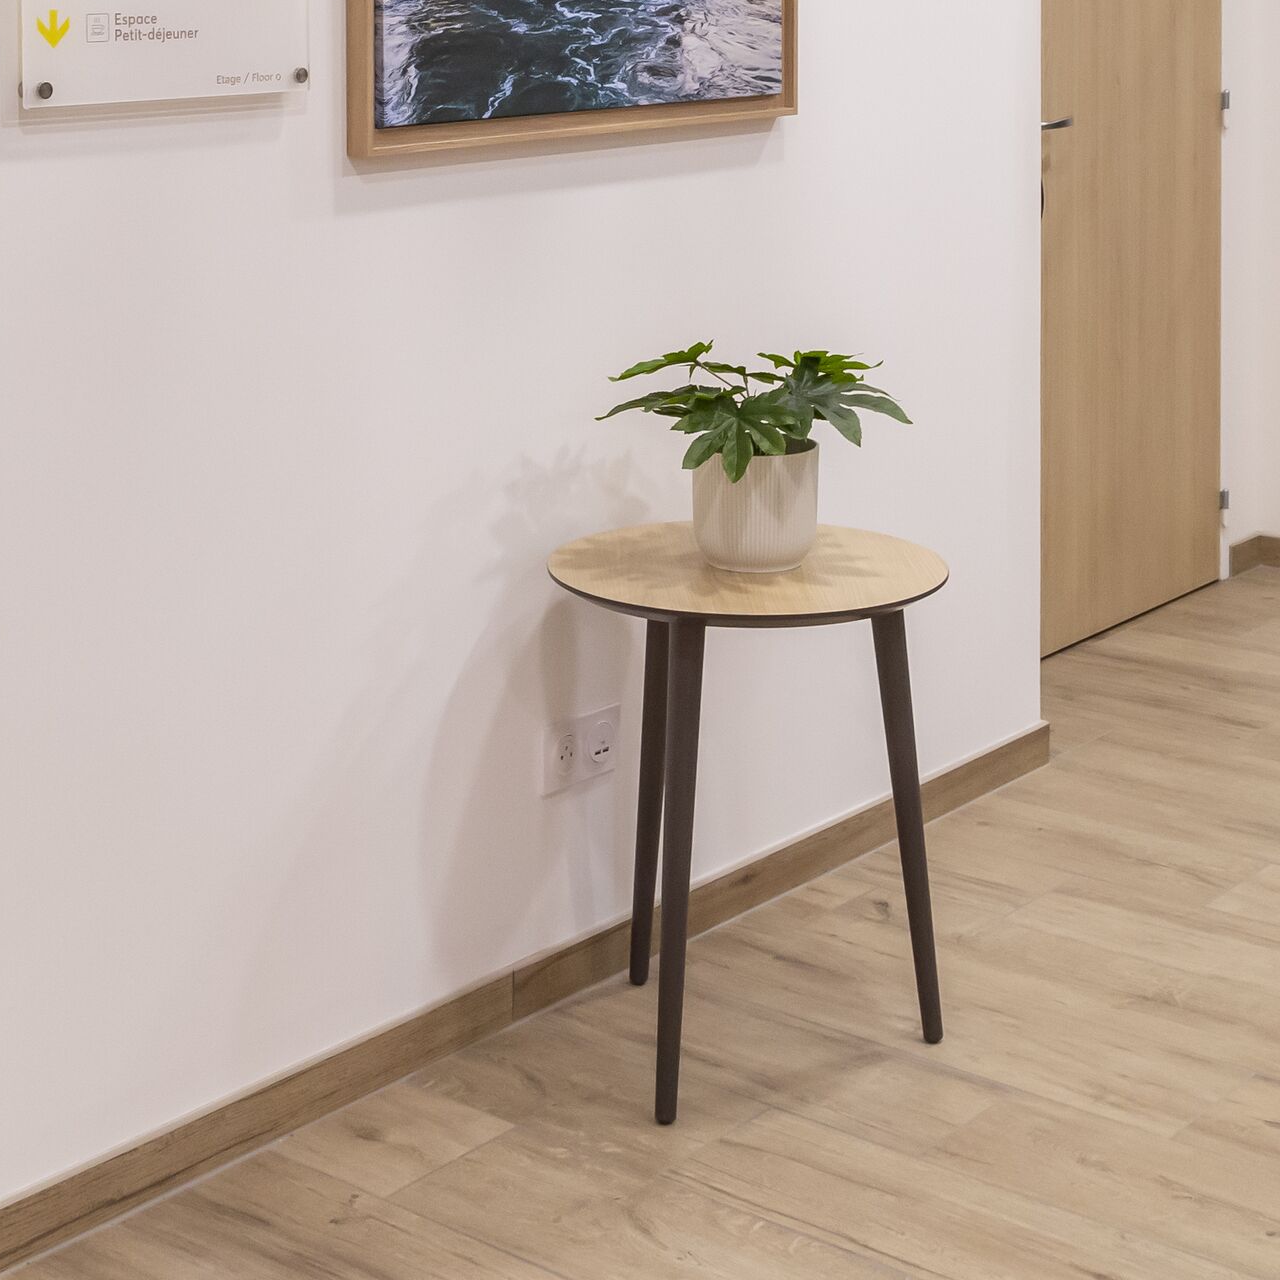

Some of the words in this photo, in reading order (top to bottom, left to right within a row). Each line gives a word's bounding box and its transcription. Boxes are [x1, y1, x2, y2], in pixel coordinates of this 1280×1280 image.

[114, 12, 158, 28] Espace
[114, 27, 199, 43] Petit-déjeuner
[216, 74, 241, 86] Etage
[252, 72, 274, 82] Floor
